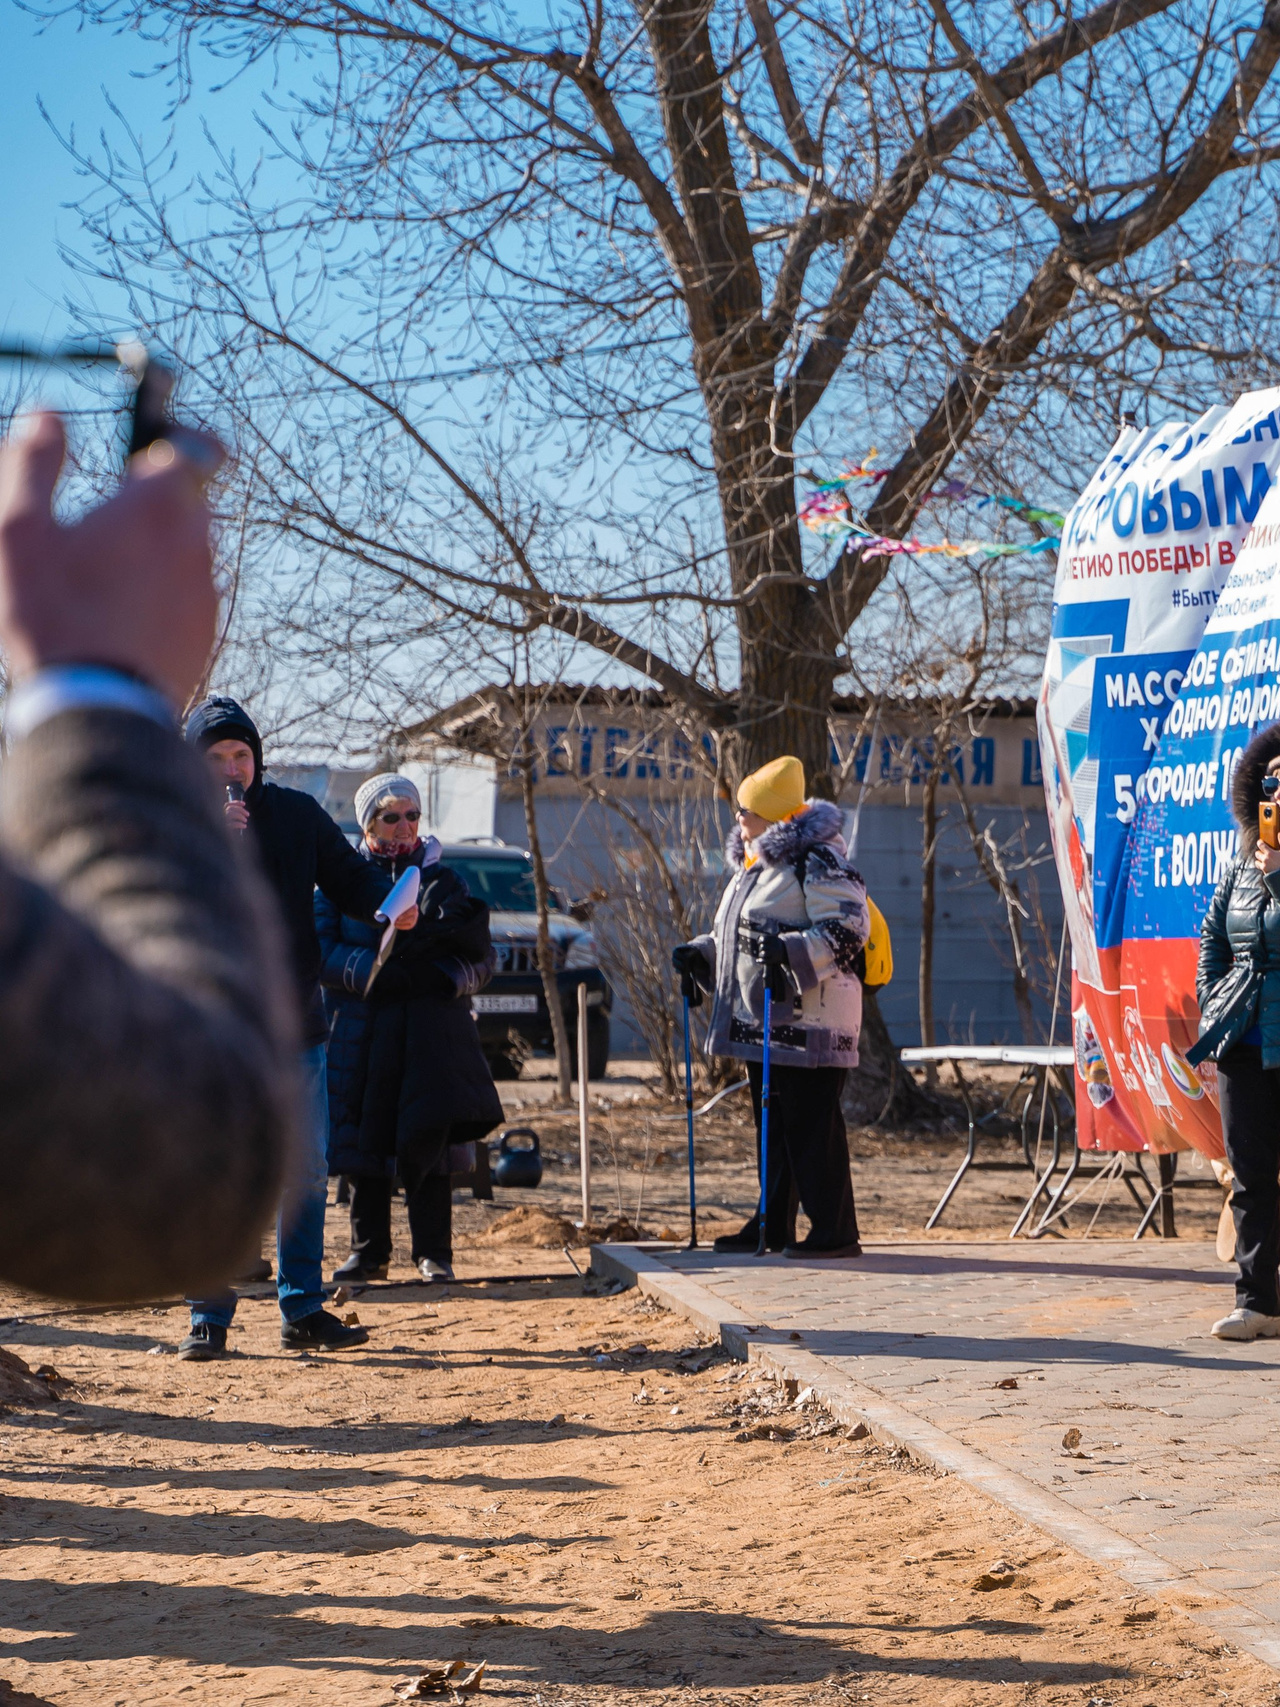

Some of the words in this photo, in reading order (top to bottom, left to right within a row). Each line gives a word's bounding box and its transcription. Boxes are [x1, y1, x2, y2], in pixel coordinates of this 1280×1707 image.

[1118, 542, 1211, 575] ПОБЕДЫ
[1218, 540, 1237, 566] В
[1171, 829, 1240, 887] ВОЛЖ
